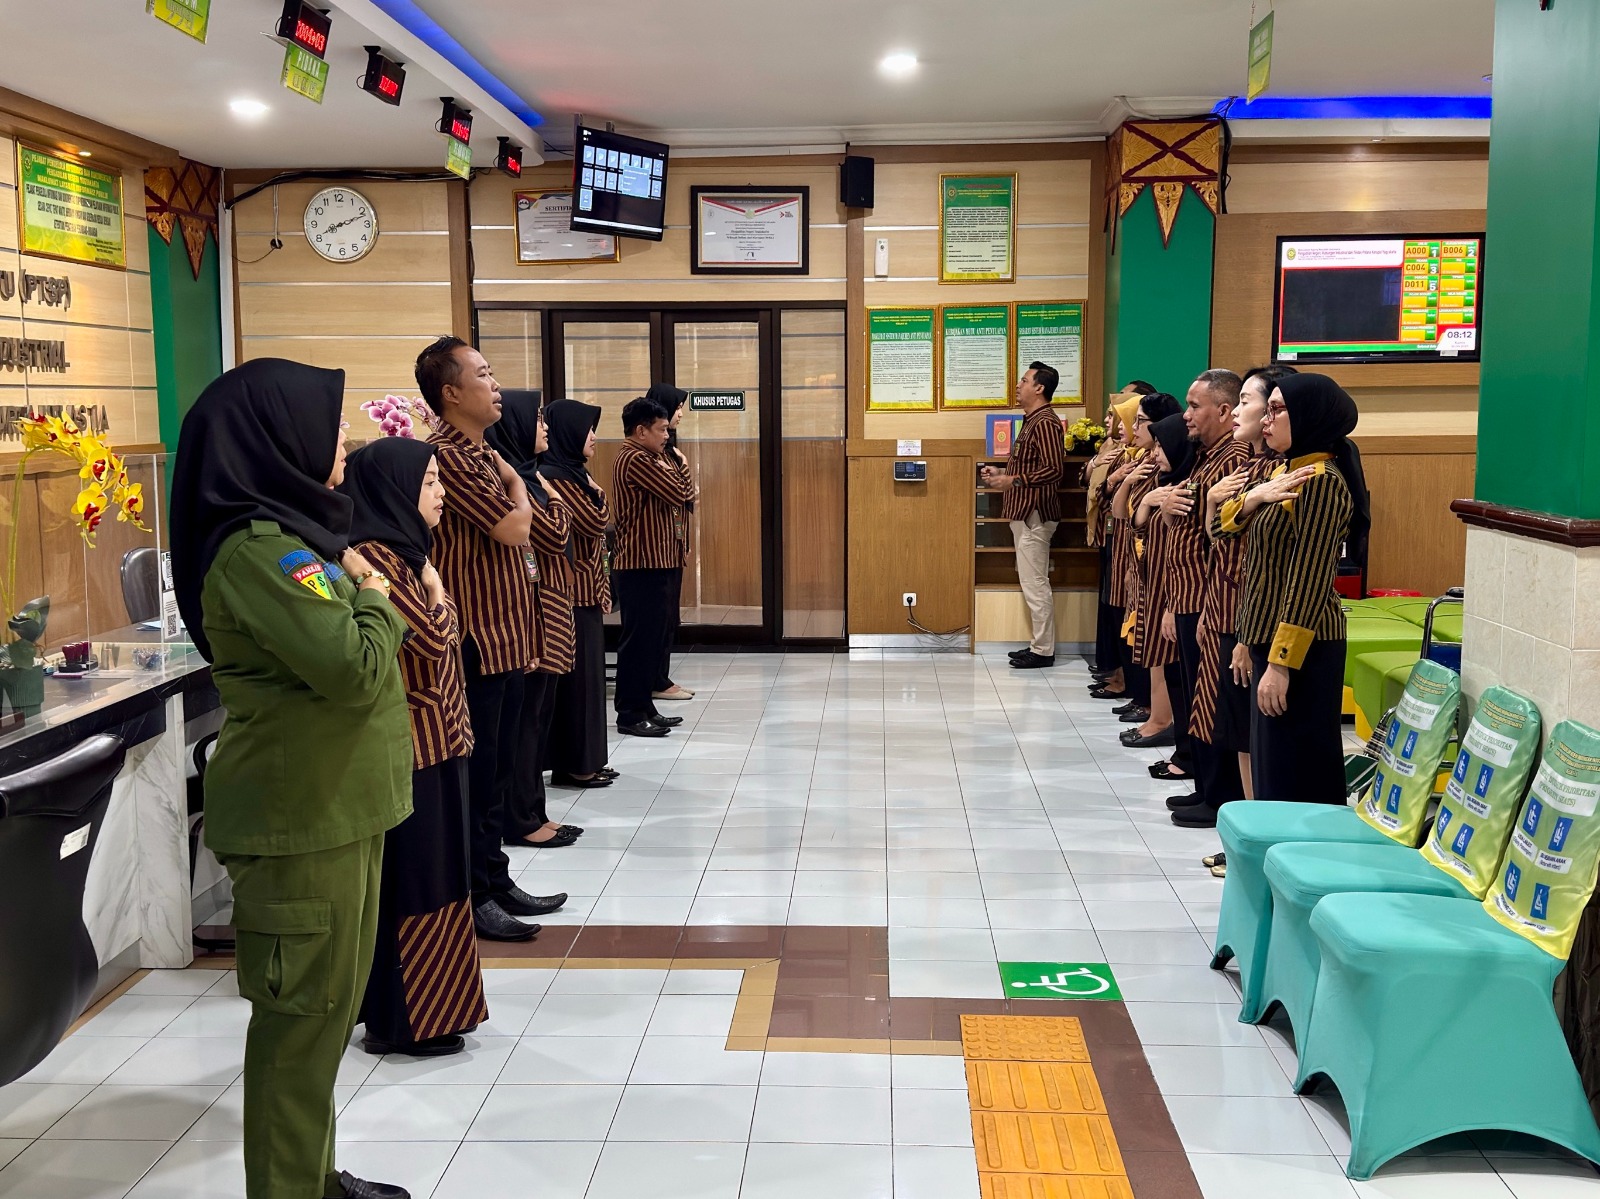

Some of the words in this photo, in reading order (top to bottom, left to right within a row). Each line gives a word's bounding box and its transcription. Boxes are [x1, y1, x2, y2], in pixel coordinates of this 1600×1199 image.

[323, 198, 329, 206] 11
[334, 194, 344, 202] 12
[314, 207, 324, 216] 10
[358, 207, 366, 216] 2
[311, 220, 318, 228] 9
[364, 220, 370, 228] 3
[316, 234, 322, 242] 8
[361, 234, 367, 242] 4
[326, 244, 332, 252] 7
[694, 396, 715, 406] KHUSUS
[716, 396, 741, 406] PETUGAS
[318, 576, 325, 586] S
